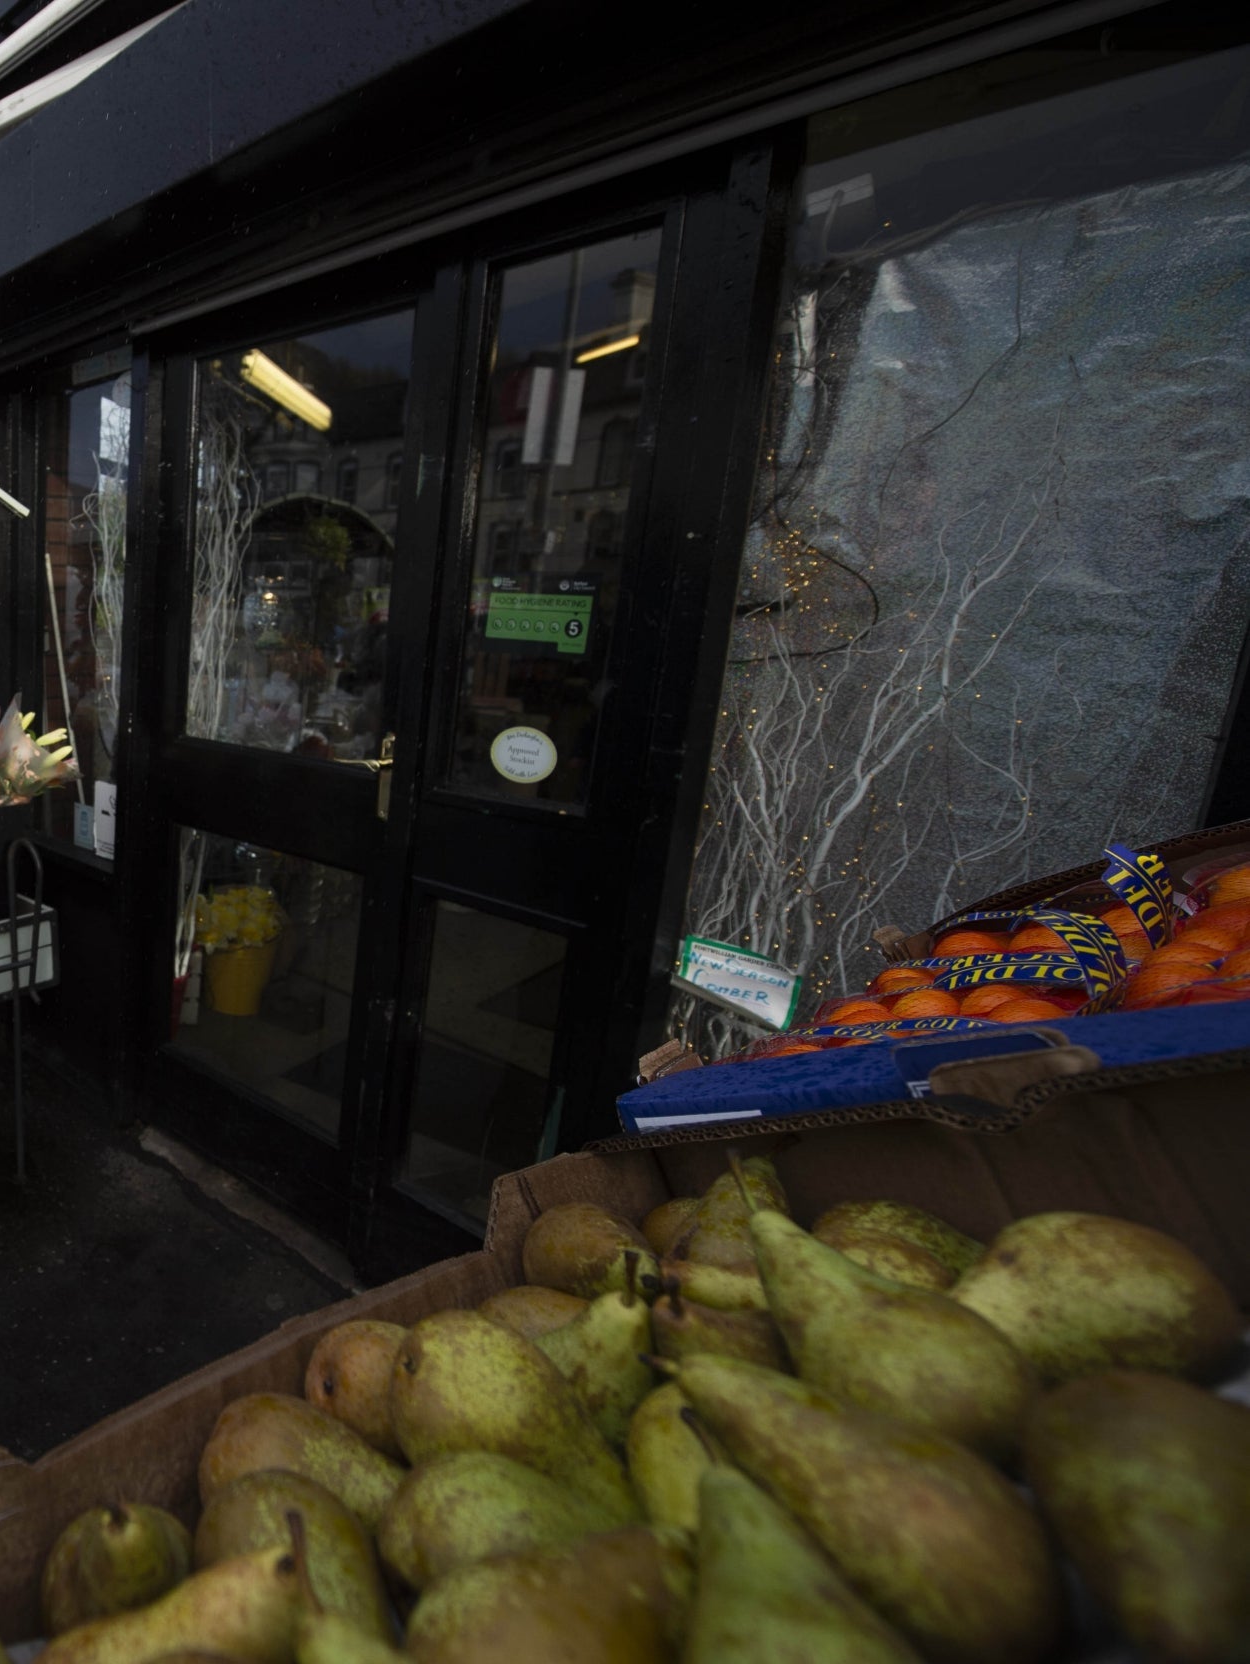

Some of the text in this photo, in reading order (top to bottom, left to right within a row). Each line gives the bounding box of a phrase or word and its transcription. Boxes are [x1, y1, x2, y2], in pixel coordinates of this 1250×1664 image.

[495, 597, 587, 608] FOOD HYGIENE RATING
[568, 622, 579, 636] 5
[508, 745, 540, 756] Approved
[766, 961, 788, 972] CENT
